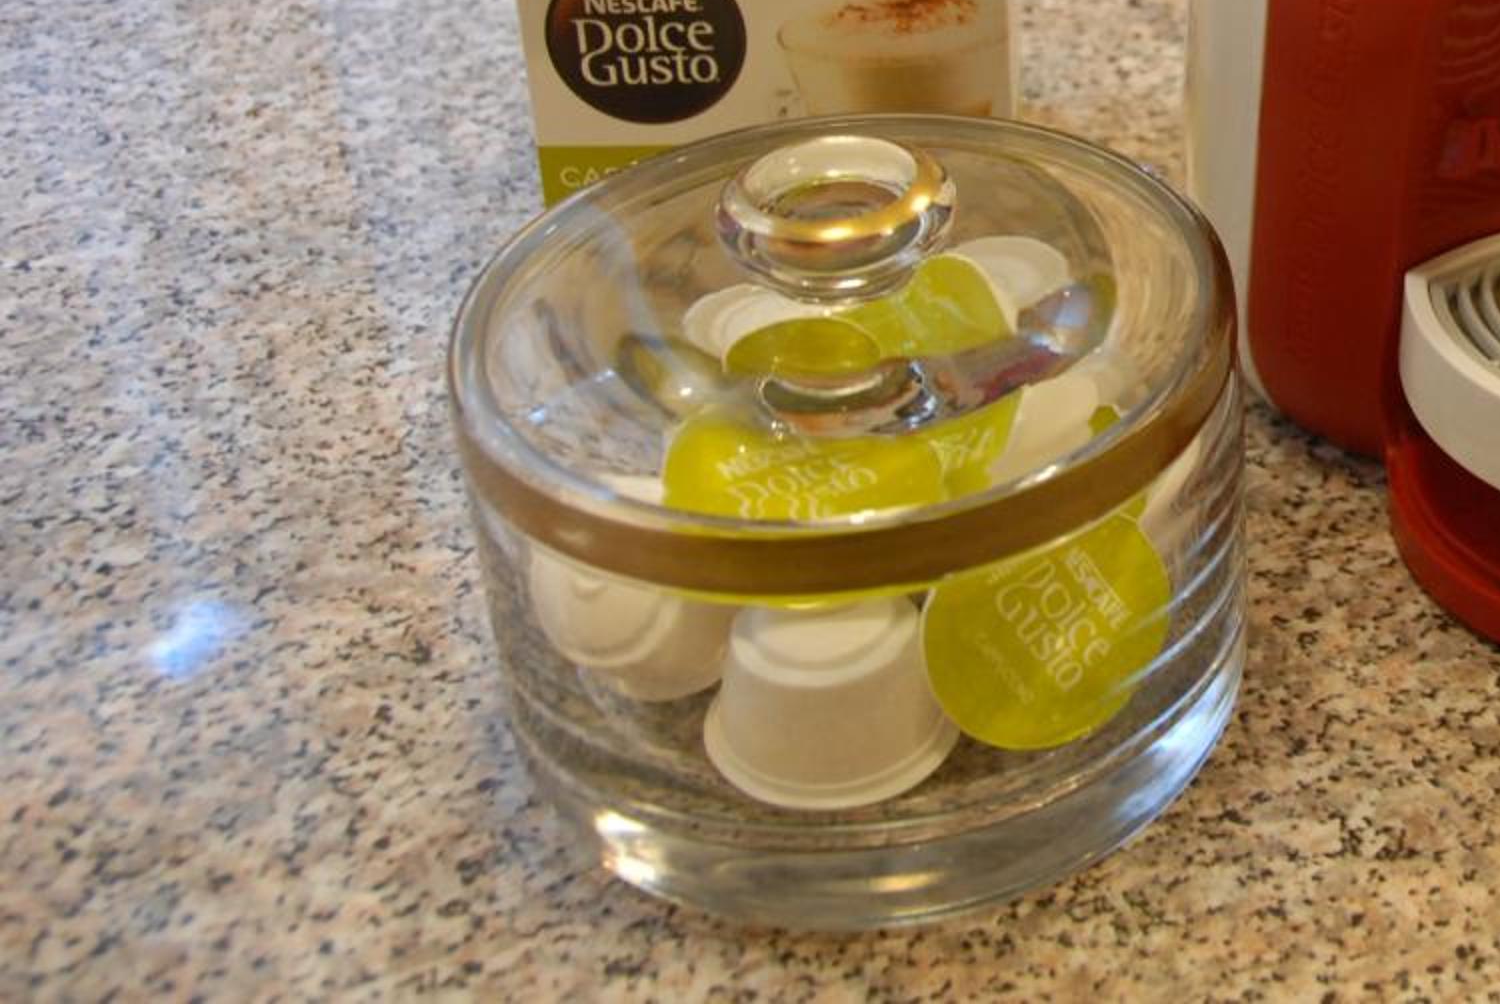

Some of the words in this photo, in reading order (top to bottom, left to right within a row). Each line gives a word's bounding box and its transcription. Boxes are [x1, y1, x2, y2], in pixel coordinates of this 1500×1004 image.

[572, 16, 714, 56] Dolce
[580, 43, 718, 86] Gusto
[995, 582, 1084, 692] Gusto
[1021, 562, 1111, 667] Dolce
